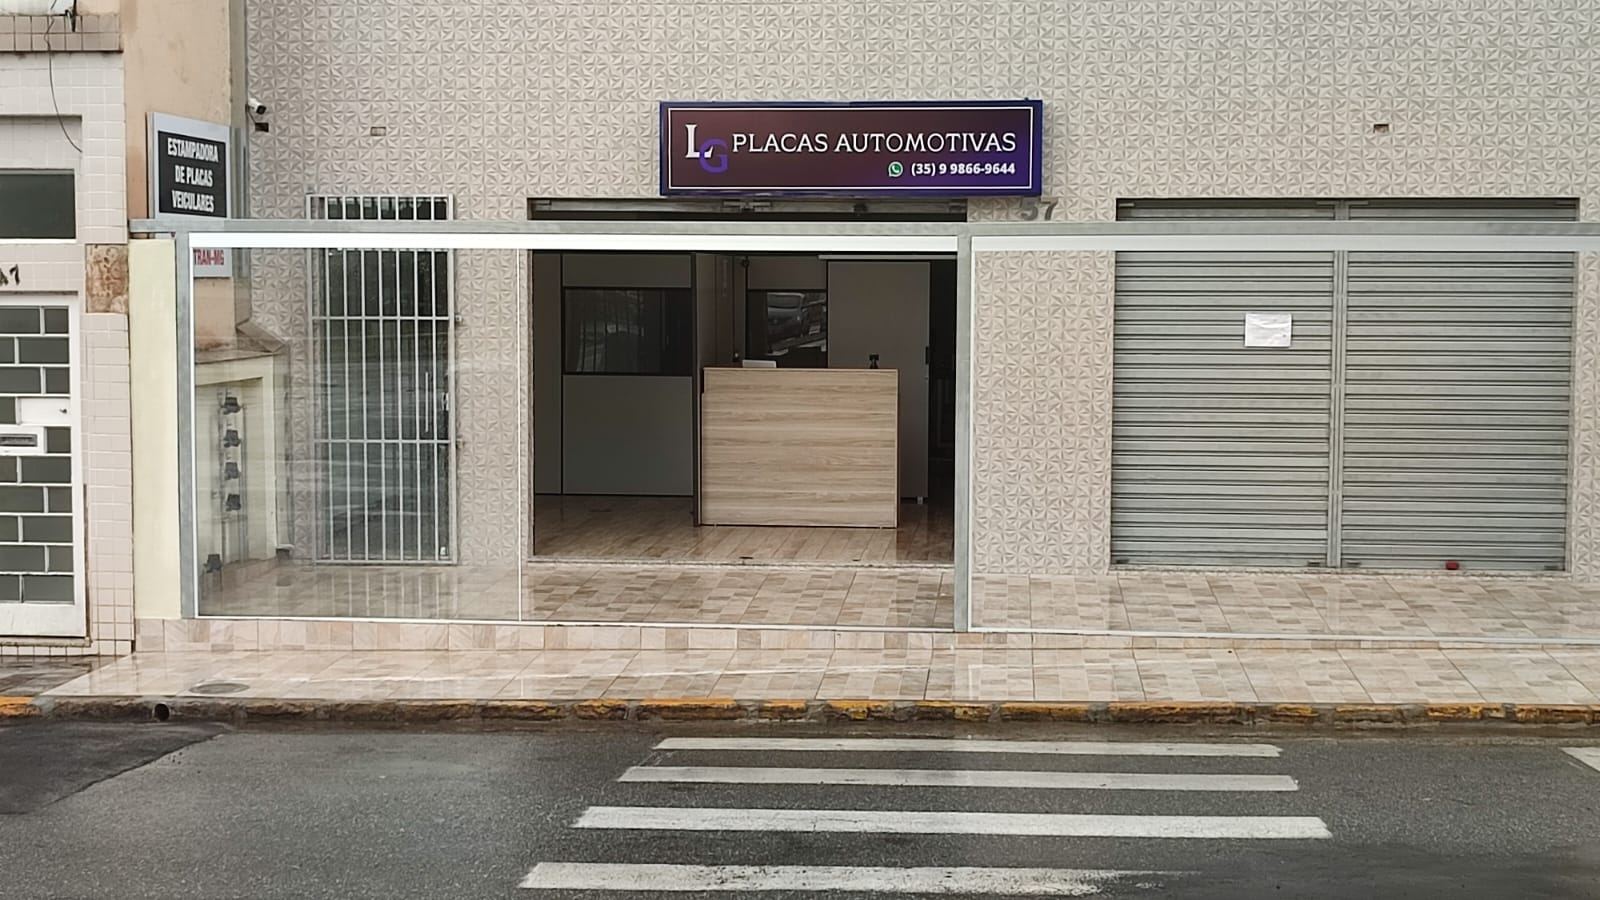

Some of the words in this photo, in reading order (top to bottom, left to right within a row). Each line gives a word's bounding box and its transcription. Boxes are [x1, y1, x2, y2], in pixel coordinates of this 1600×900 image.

[167, 137, 219, 162] ESTAMPADORA
[732, 133, 828, 152] PLACAS
[834, 132, 1016, 152] AUTOMOTIVAS
[175, 165, 185, 184] DE
[187, 167, 213, 188] PLACAS
[911, 163, 936, 176] (35)
[939, 163, 947, 174] 9
[950, 163, 1016, 174] 9866-9644
[171, 190, 214, 213] VEICULARES
